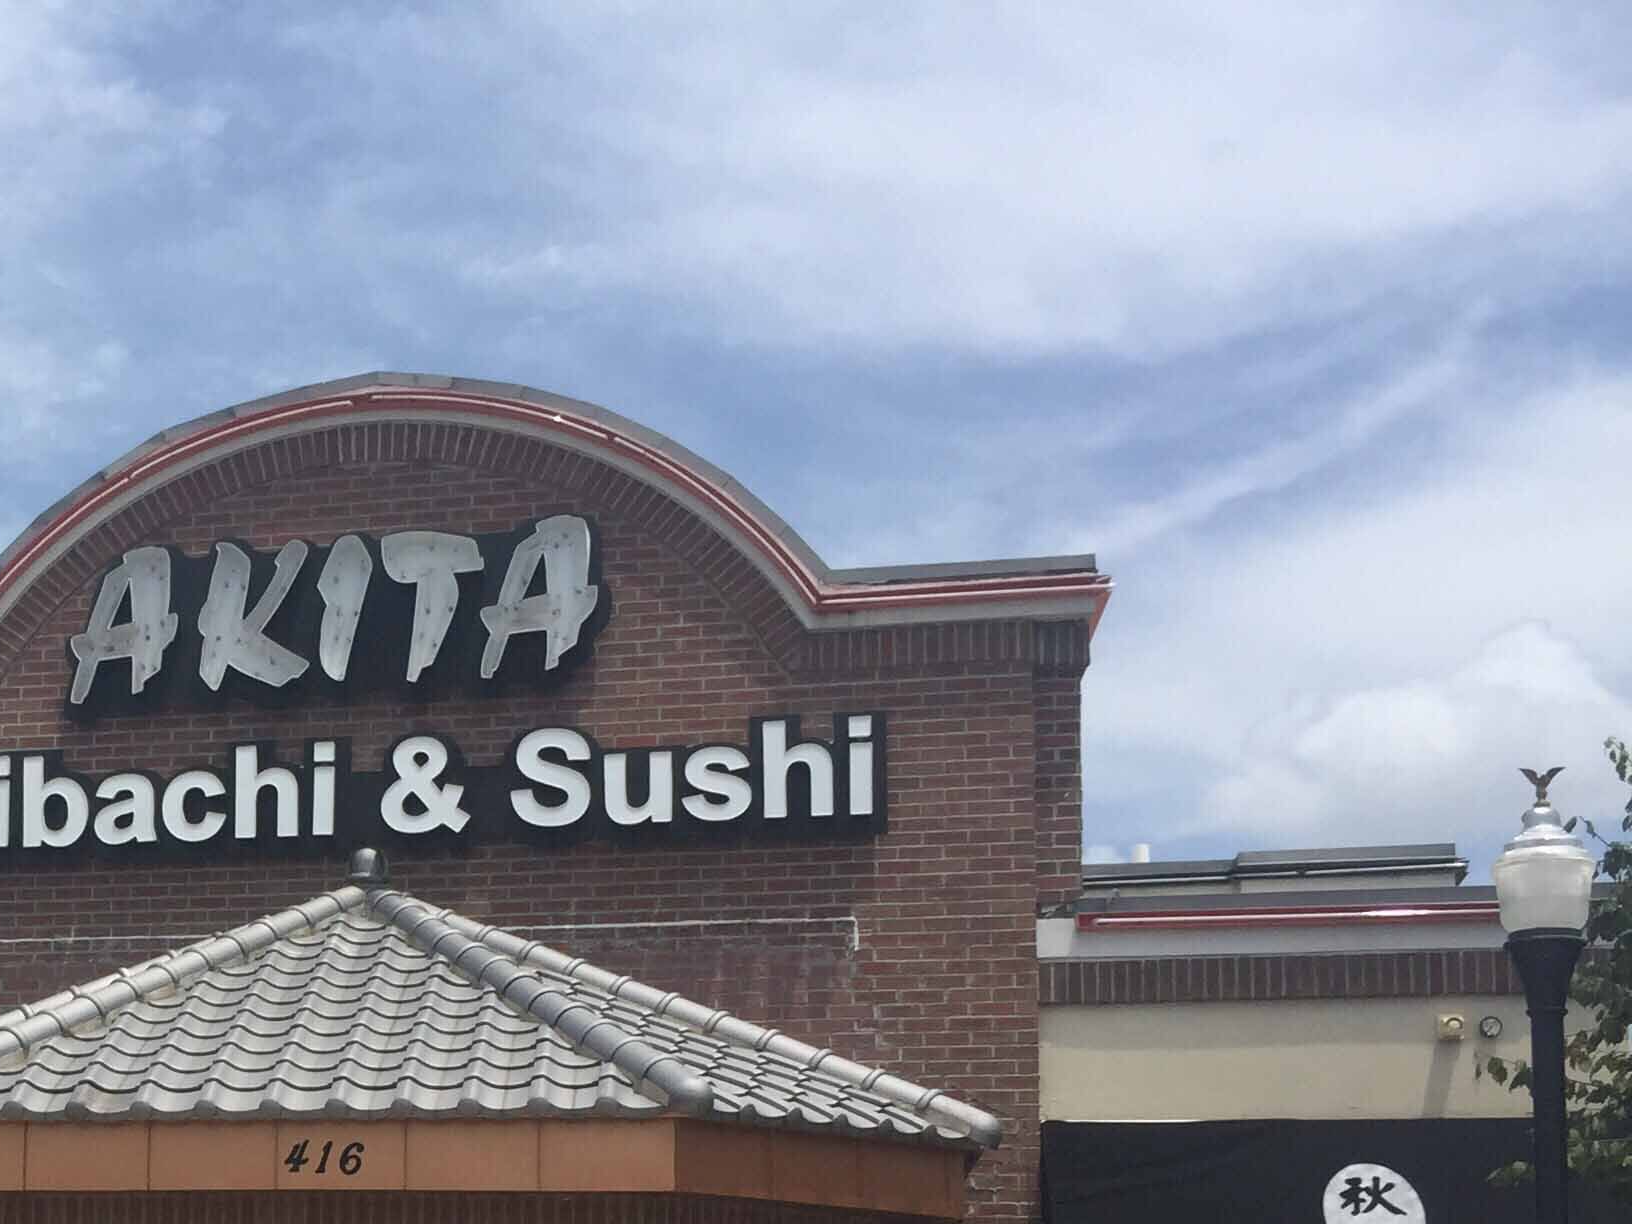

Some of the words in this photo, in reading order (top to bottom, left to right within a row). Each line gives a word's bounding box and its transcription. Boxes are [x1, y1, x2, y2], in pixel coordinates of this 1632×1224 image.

[70, 513, 598, 705] AKITA
[380, 735, 470, 834] &
[510, 714, 875, 828] Sushi
[284, 1139, 366, 1176] 416
